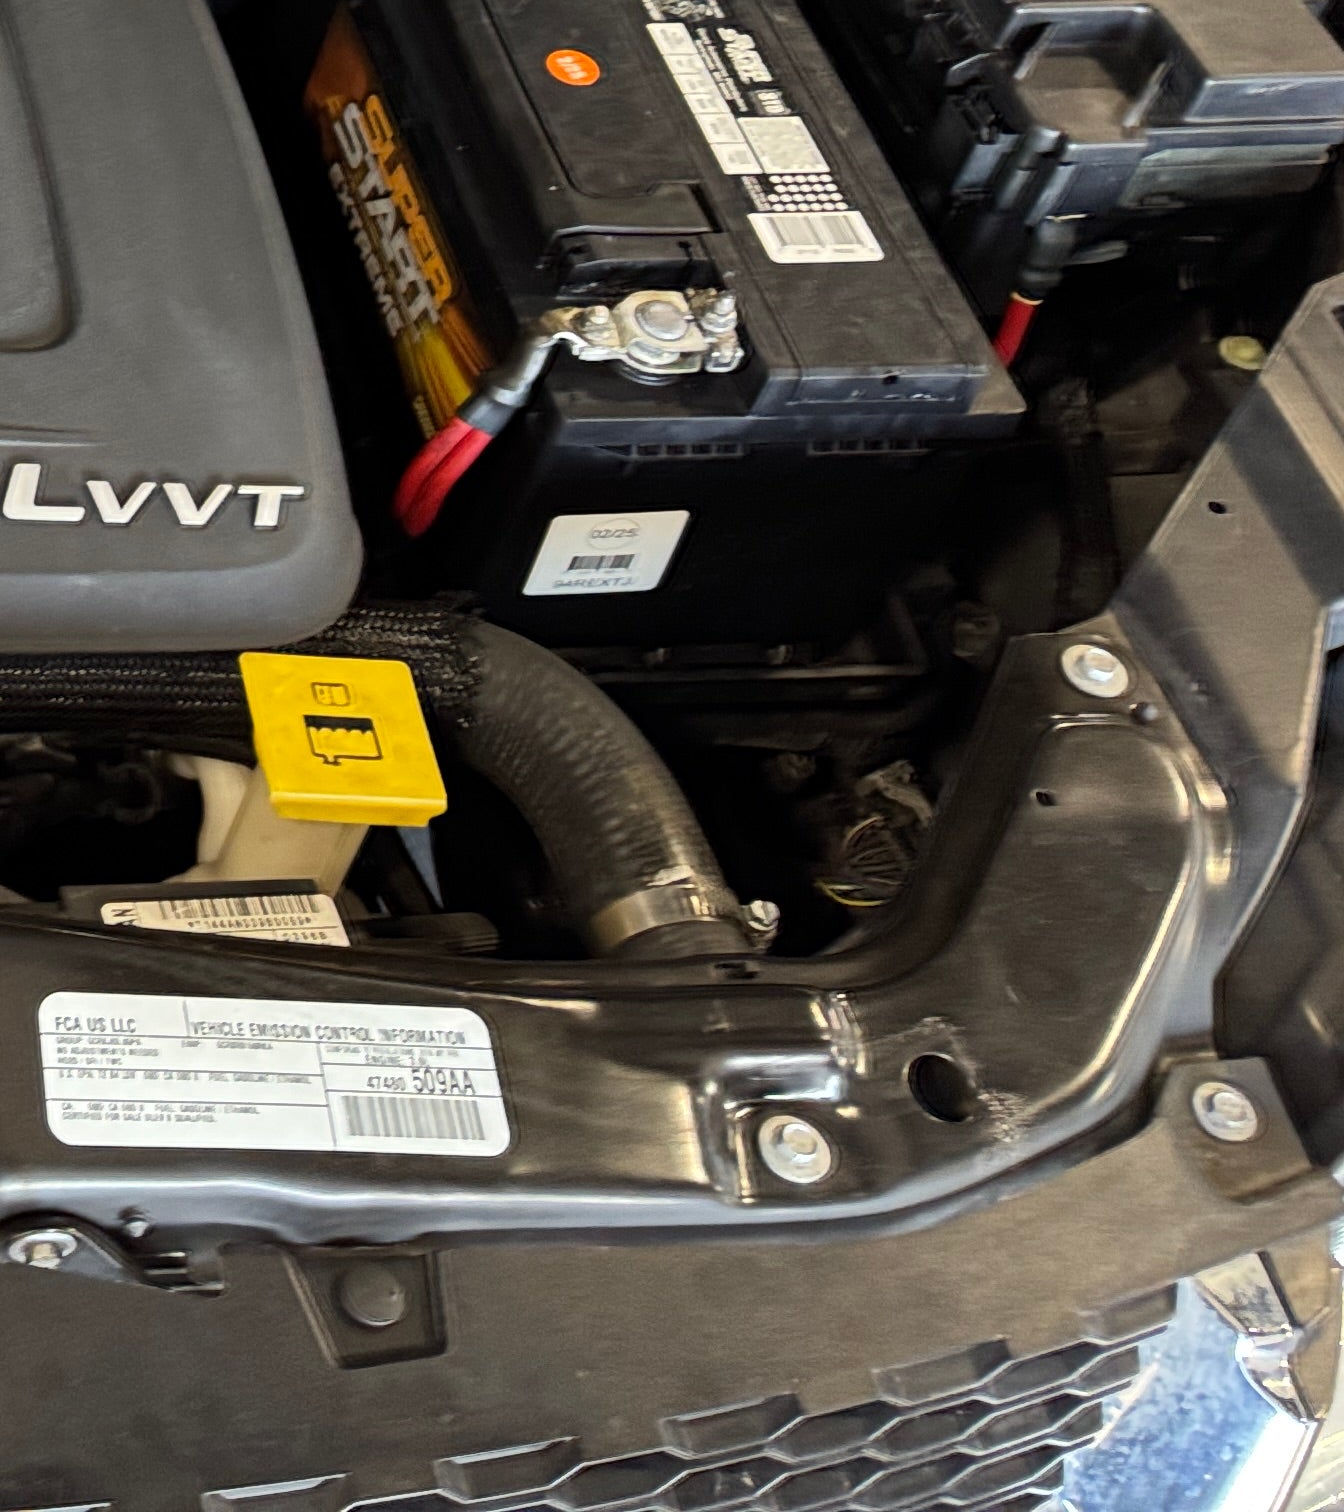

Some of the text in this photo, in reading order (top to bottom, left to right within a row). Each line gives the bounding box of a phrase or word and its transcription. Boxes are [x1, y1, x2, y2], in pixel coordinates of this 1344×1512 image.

[334, 102, 442, 344] START
[54, 1015, 137, 1034] FCA US LLC
[190, 1020, 466, 1045] VEHICLE EMISSION CONTROL INFORMATION
[411, 1067, 477, 1096] 509AA
